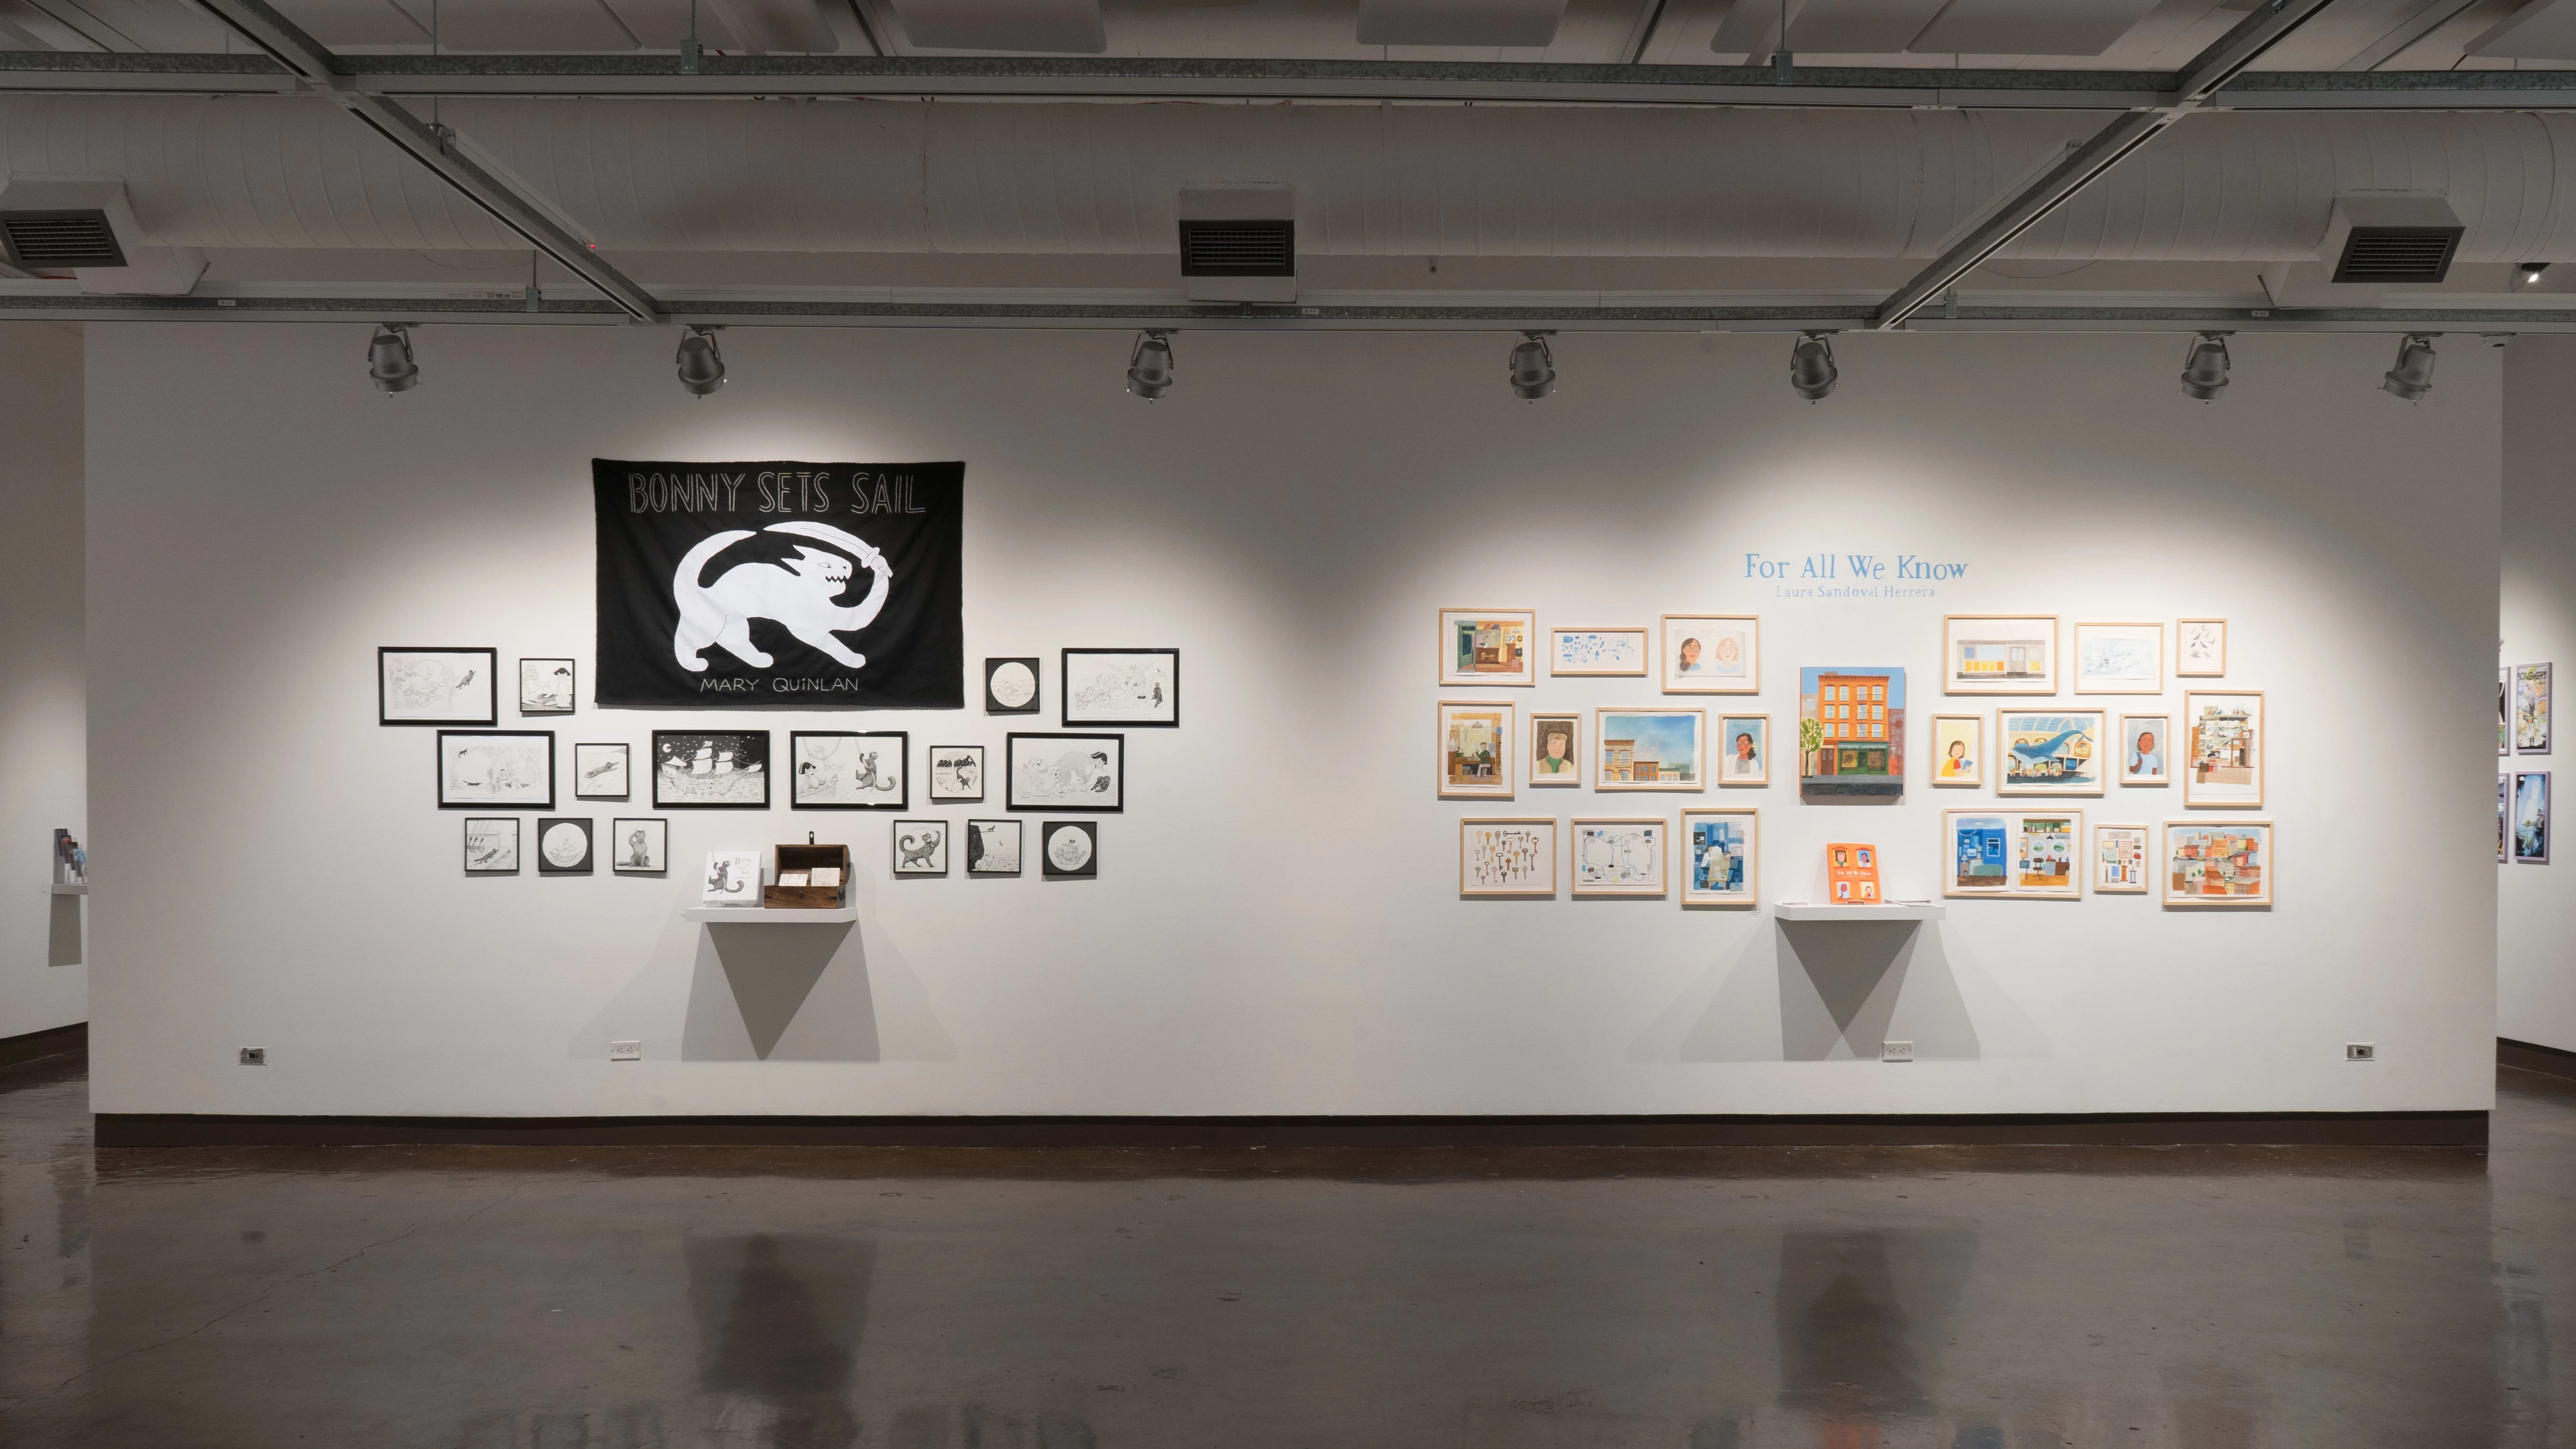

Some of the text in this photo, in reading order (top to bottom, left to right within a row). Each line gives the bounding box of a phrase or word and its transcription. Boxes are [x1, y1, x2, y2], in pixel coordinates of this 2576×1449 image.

[629, 472, 925, 514] BONNY SETS SAIL
[1745, 553, 1969, 581] For All We Know
[1776, 585, 1936, 598] Laura Sandoval Herrera
[700, 678, 759, 692] MARY
